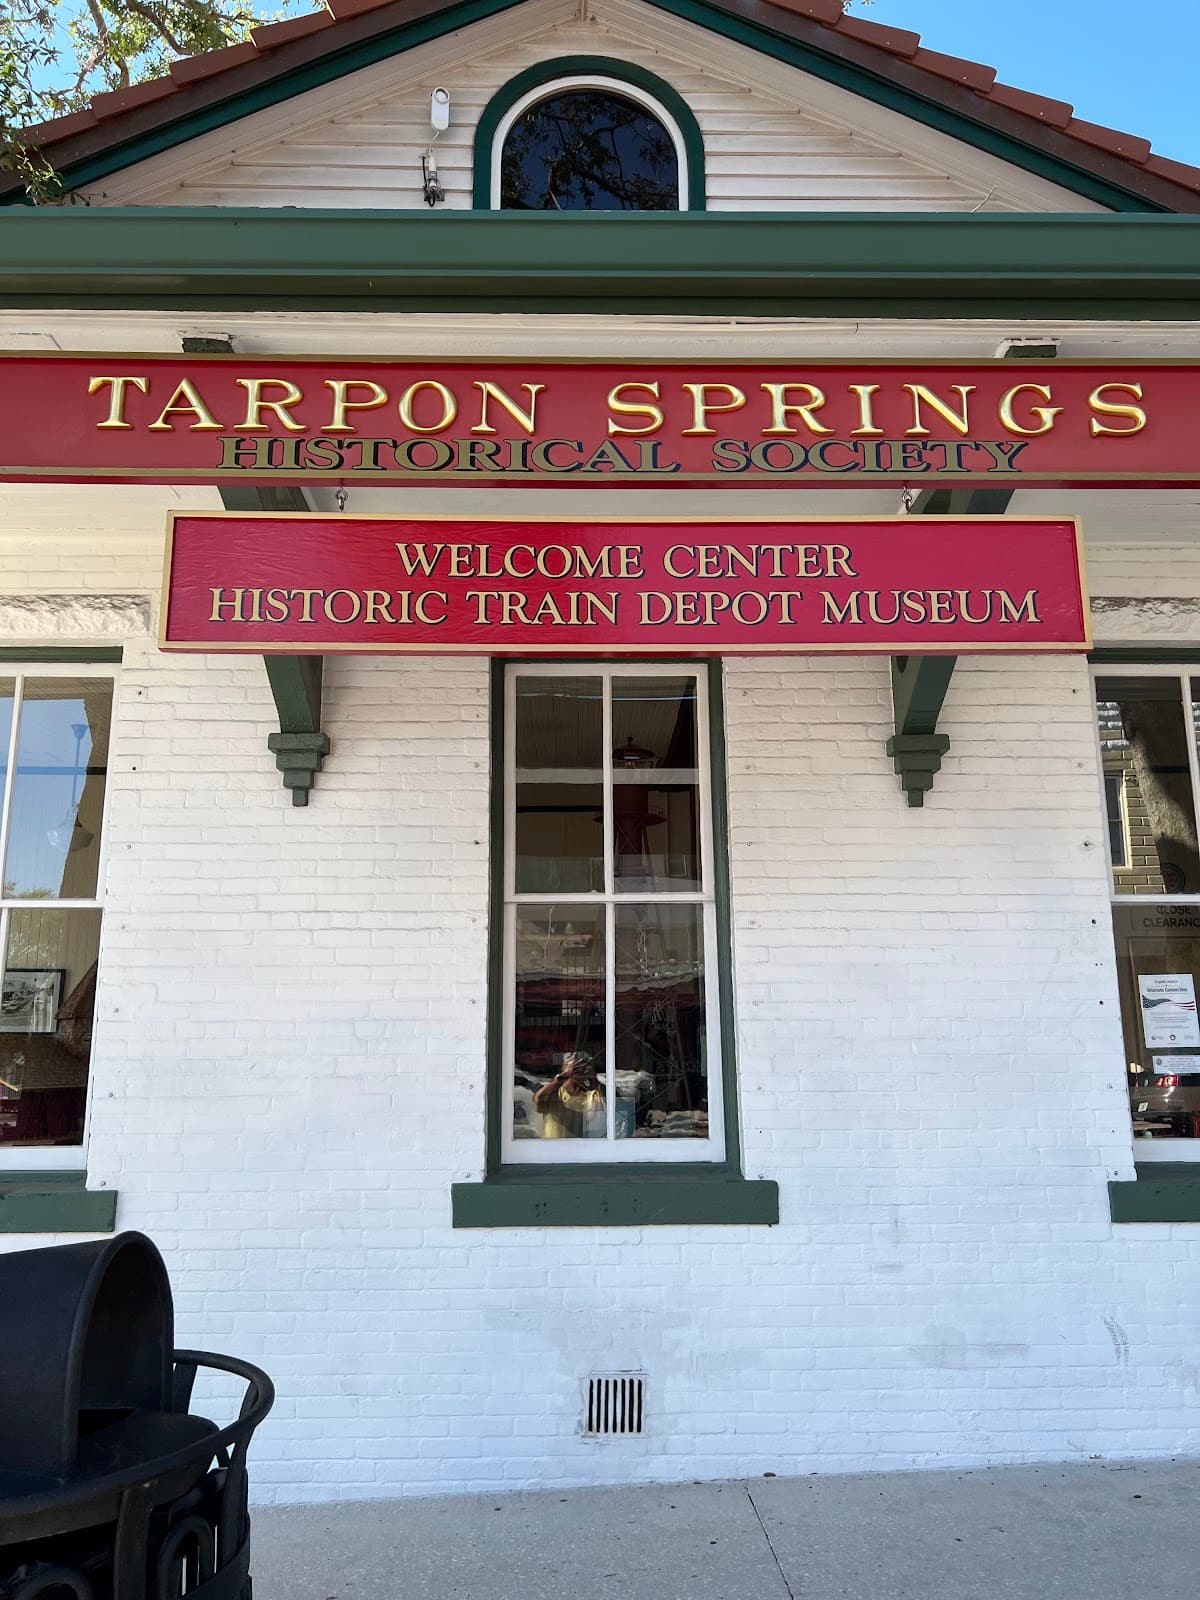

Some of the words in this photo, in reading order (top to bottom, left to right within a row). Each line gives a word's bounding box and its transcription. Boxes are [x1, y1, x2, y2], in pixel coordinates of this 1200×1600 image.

[86, 375, 547, 435] TARPON
[607, 381, 1148, 437] SPRINGS
[216, 436, 680, 473] HISTORICAL
[711, 439, 1029, 474] SOCIETY
[395, 542, 644, 579] WELCOME
[663, 544, 858, 579] CENTER
[208, 587, 449, 625] HISTORIC
[465, 590, 619, 625] TRAIN
[638, 591, 802, 625] DEPOT
[820, 589, 1042, 624] MUSEUM
